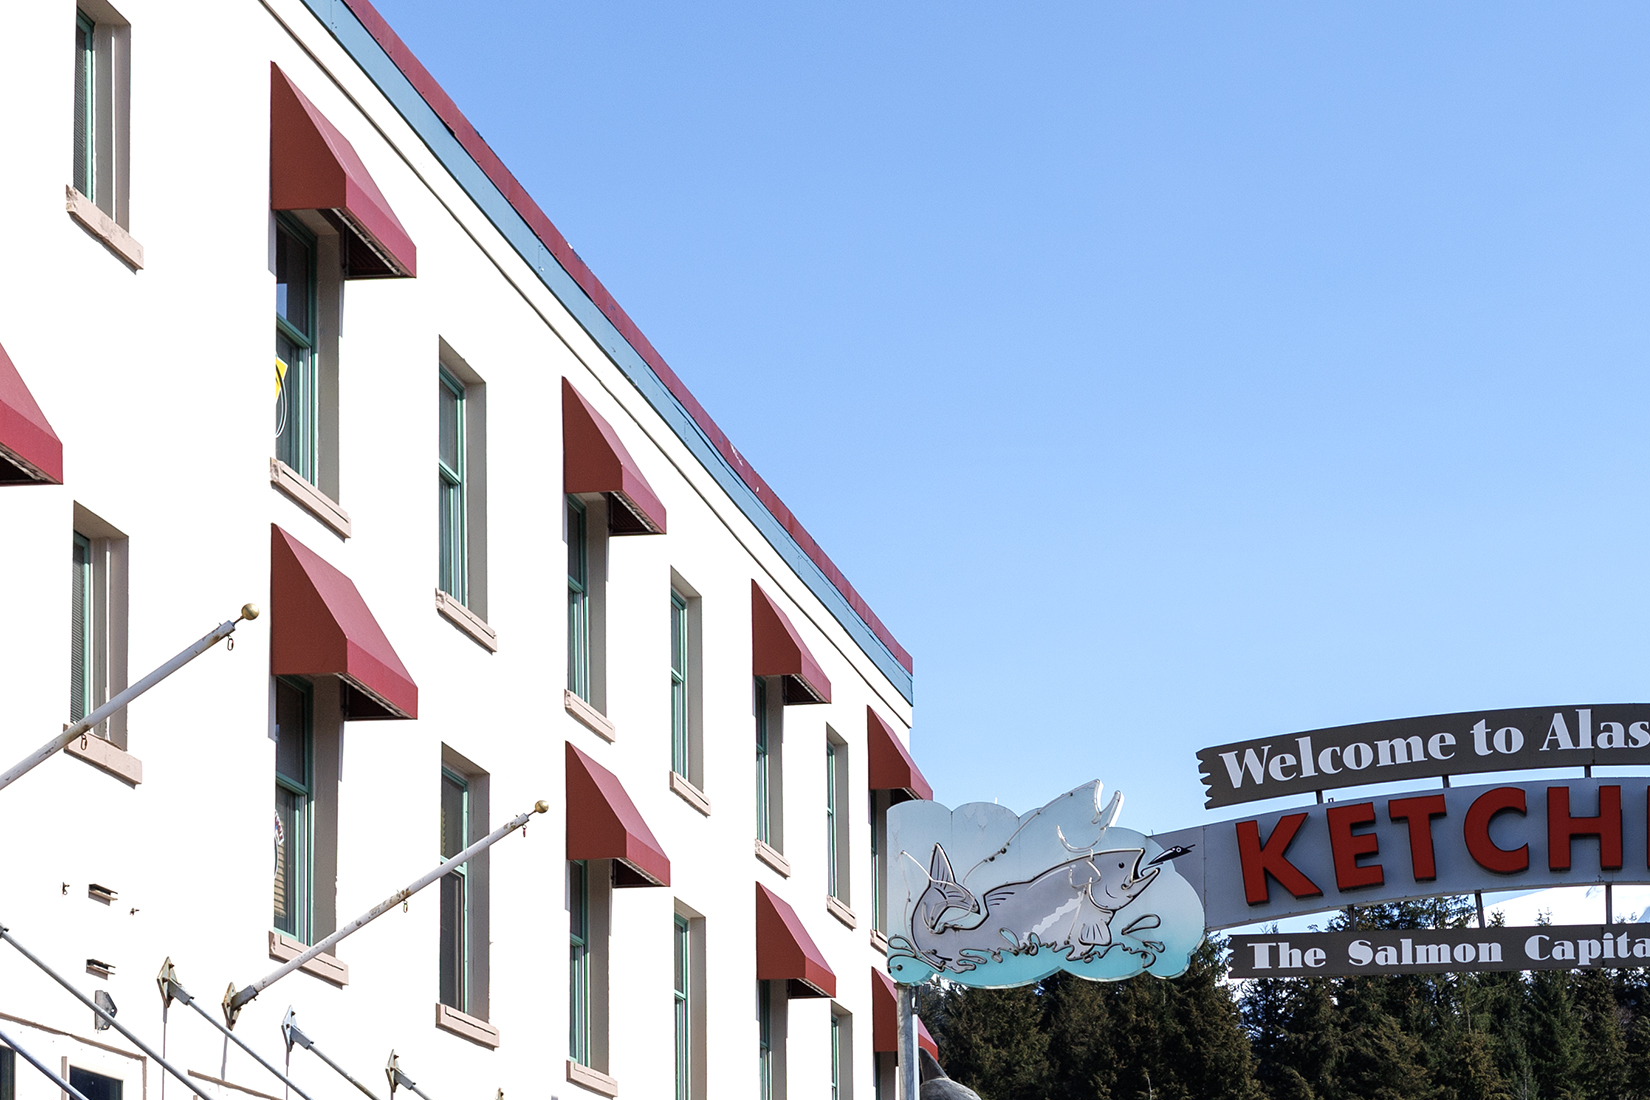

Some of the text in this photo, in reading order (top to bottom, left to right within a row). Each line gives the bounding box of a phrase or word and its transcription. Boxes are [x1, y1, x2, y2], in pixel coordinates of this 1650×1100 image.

[1218, 732, 1456, 789] Welcome
[1470, 719, 1524, 756] to
[1247, 942, 1327, 969] The
[1348, 938, 1503, 966] Salmon
